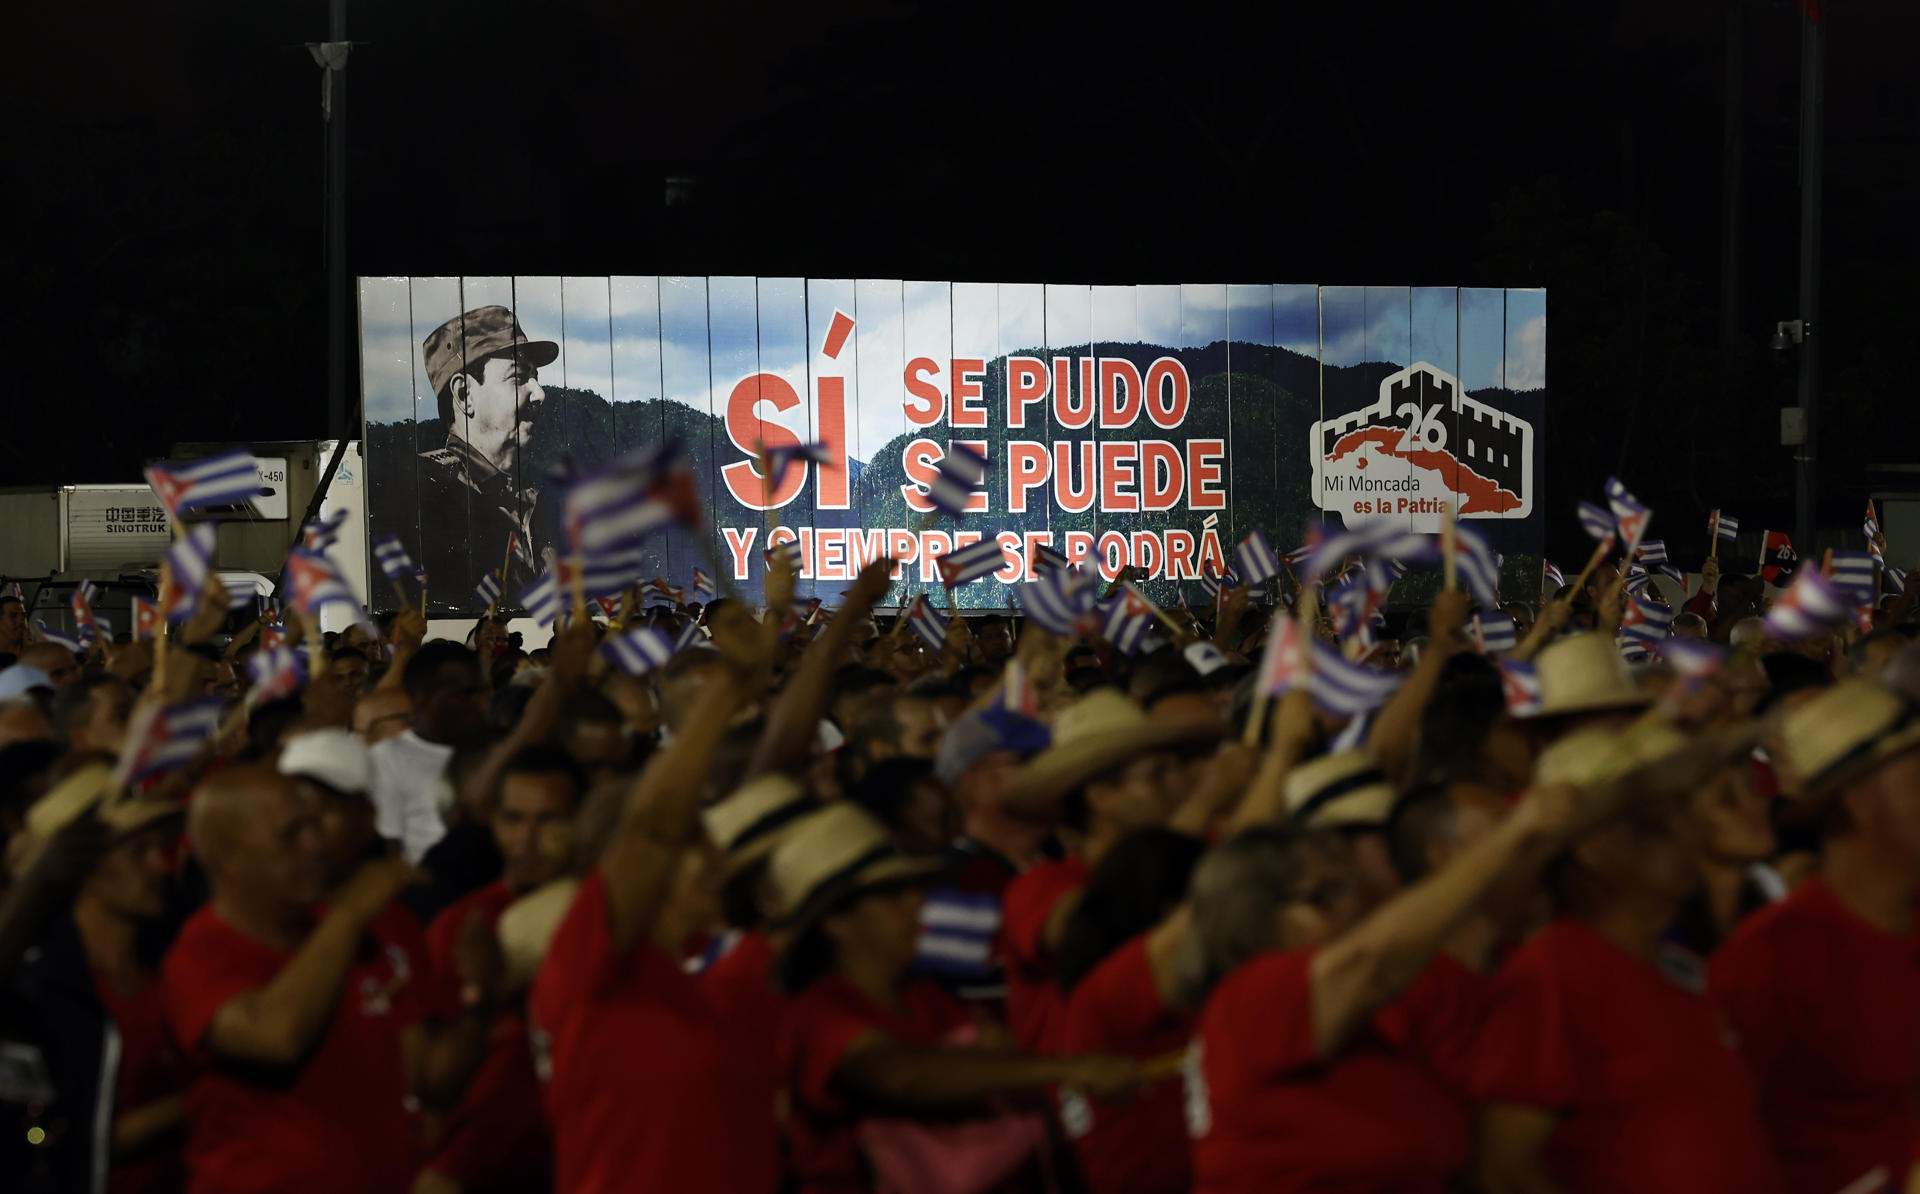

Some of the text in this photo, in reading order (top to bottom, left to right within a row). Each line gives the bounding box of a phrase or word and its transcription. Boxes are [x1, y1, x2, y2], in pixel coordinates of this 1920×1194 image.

[720, 307, 856, 511] SÍ
[902, 356, 1191, 430] SE PUDO
[1395, 402, 1448, 452] 26
[1007, 438, 1226, 513] PUEDE
[1324, 475, 1420, 491] Mi Moncada
[106, 507, 166, 522] 中国重汽
[1353, 500, 1372, 513] es
[1377, 498, 1392, 513] la
[106, 524, 167, 533] SINOTRUK
[722, 527, 758, 580] Y
[1776, 544, 1791, 560] 26
